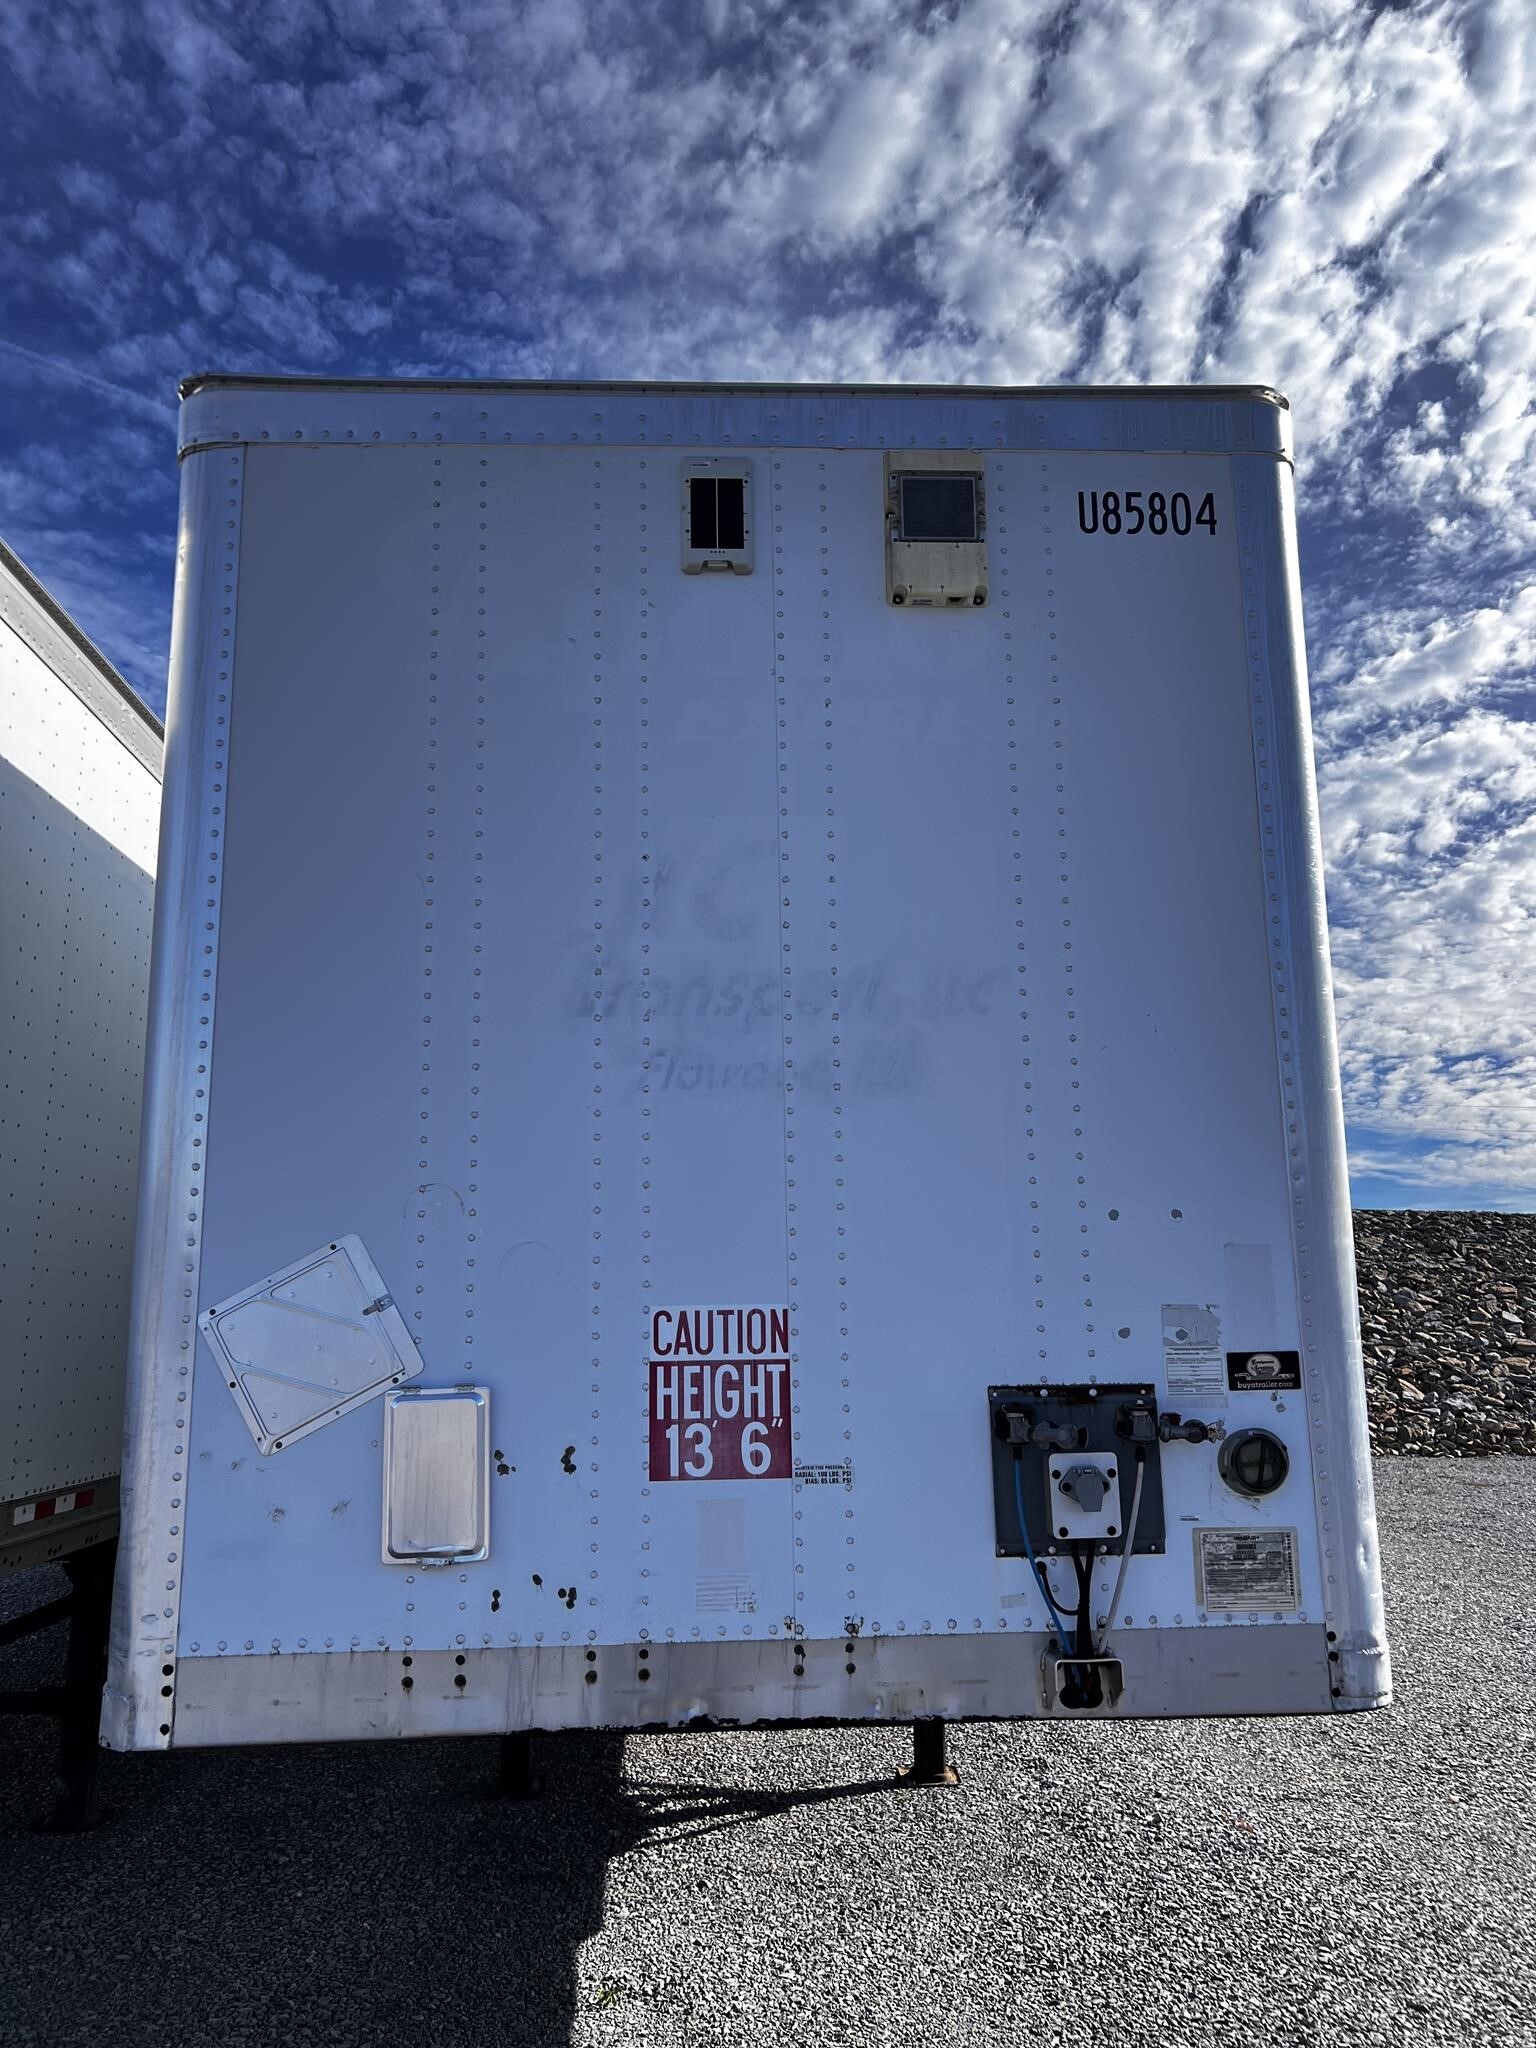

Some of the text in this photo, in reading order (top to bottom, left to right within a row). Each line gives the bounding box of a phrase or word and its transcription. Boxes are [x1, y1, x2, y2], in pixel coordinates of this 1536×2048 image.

[1077, 491, 1218, 536] U85804
[652, 1308, 790, 1356] CAUTION
[655, 1363, 787, 1420] HEIGHT
[1236, 1381, 1294, 1390] buyatrailer.com
